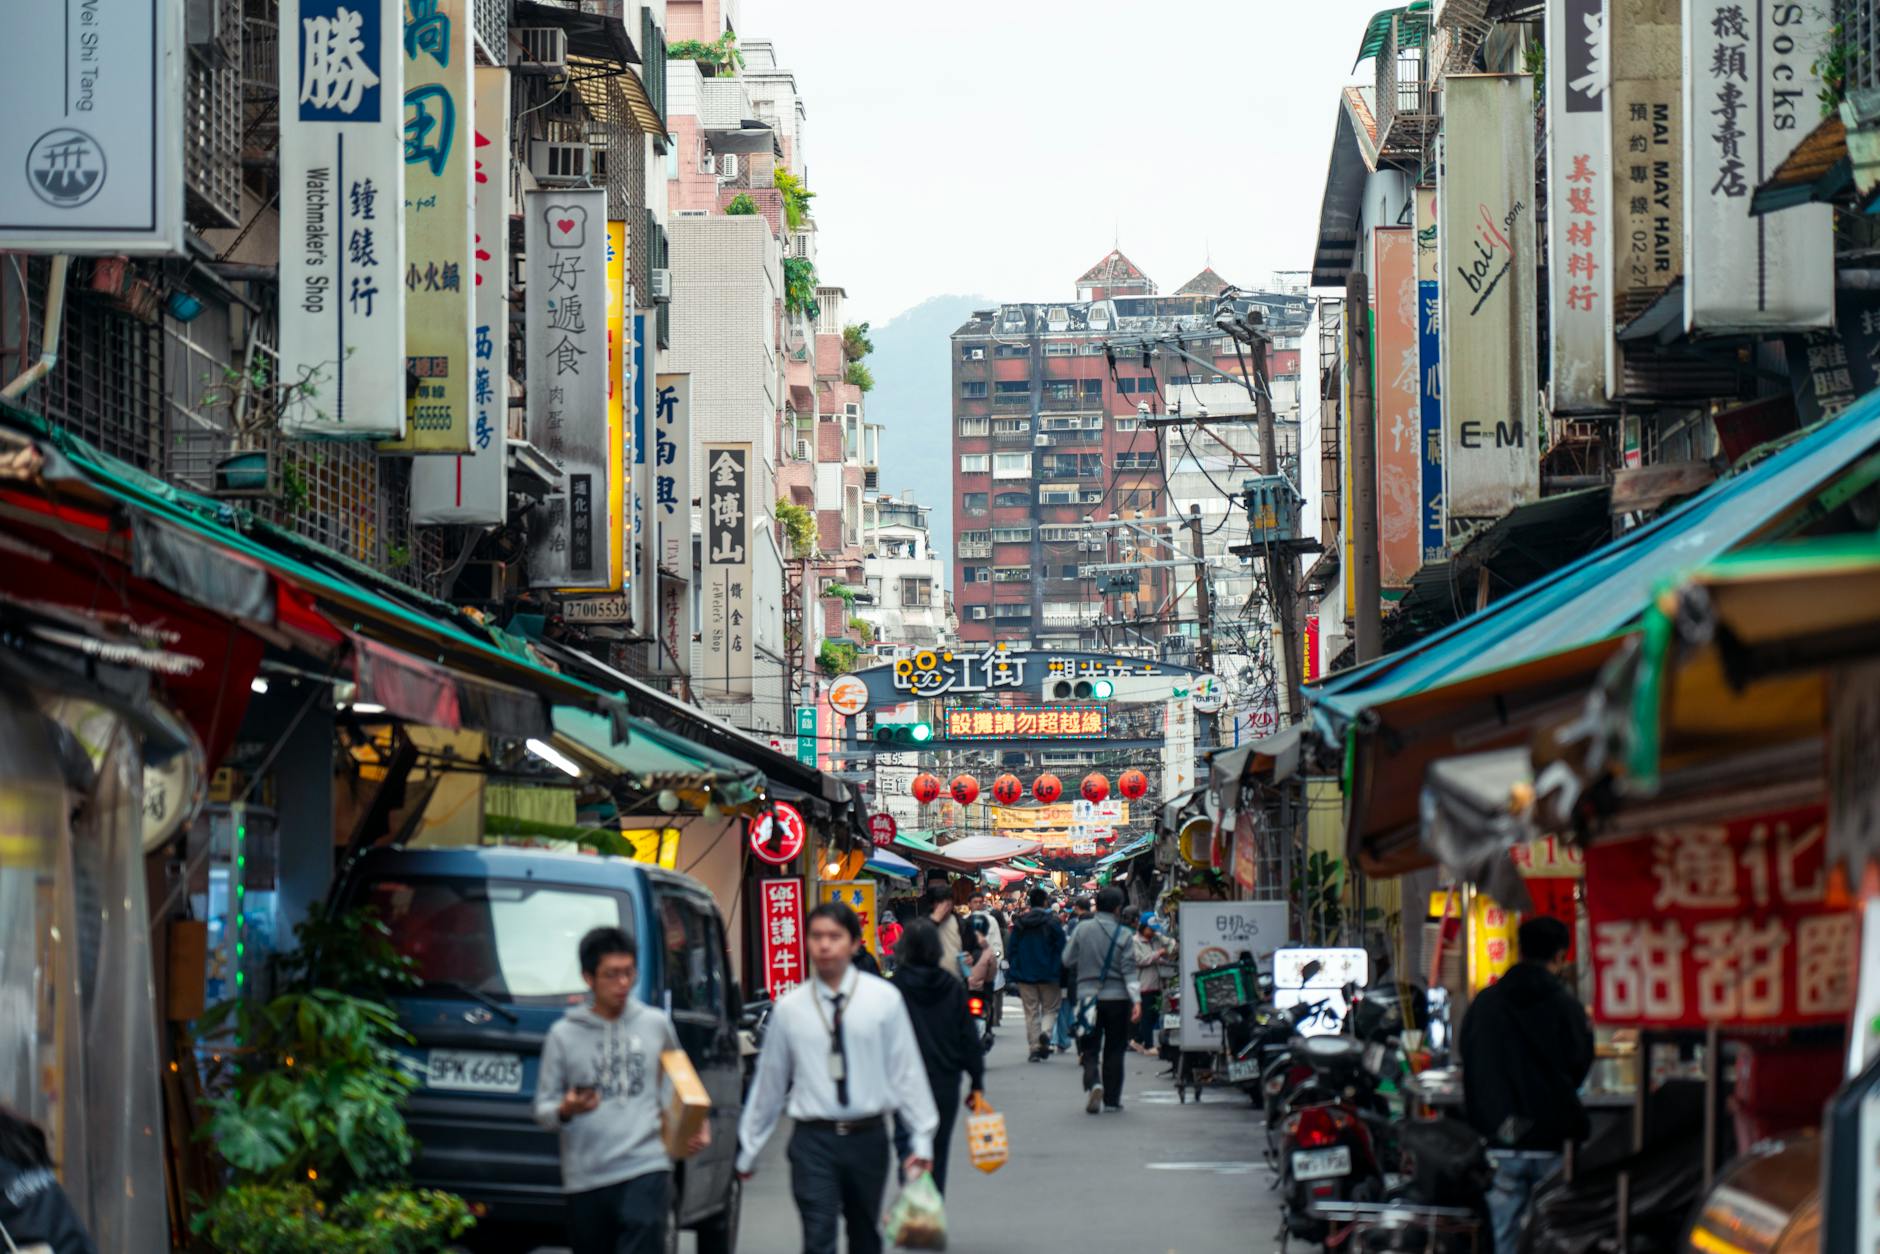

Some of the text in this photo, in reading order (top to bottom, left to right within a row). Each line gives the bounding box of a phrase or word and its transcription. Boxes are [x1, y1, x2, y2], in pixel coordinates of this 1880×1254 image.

[76, 66, 98, 112] Tang
[80, 32, 98, 62] Shi
[299, 5, 380, 114] 勝
[1772, 4, 1804, 131] Socks
[301, 167, 330, 314] Watchmaker's Shop
[1566, 153, 1598, 312] 美髮材料行
[1653, 103, 1671, 273] MAI MAY HAIR
[349, 178, 379, 318] 鐘錶行
[406, 260, 461, 293] 小火鍋
[546, 252, 587, 376] 好遞食
[710, 451, 745, 562] 金博山
[568, 602, 627, 617] 27005539
[711, 628, 724, 653] Shop
